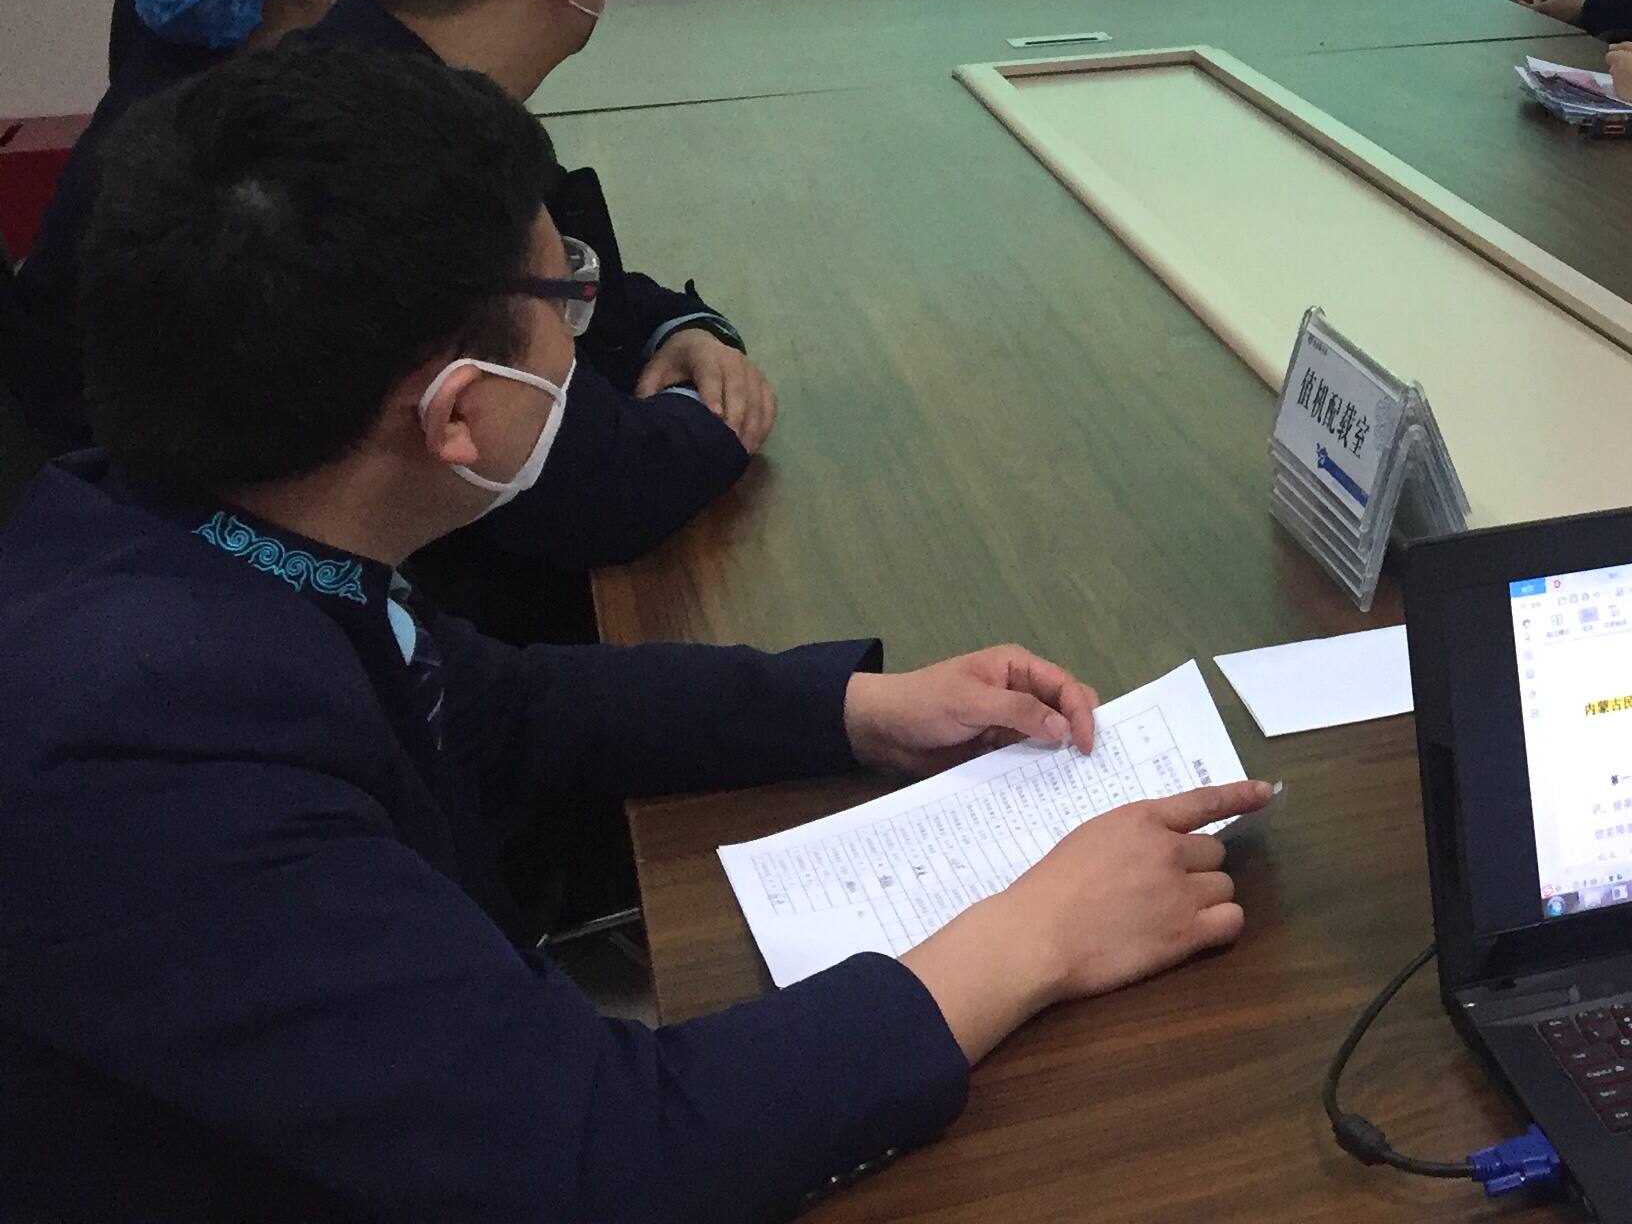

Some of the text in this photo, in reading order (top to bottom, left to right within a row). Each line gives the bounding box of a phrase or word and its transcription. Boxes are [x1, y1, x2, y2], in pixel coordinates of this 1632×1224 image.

[1297, 367, 1371, 459] 值机配载室
